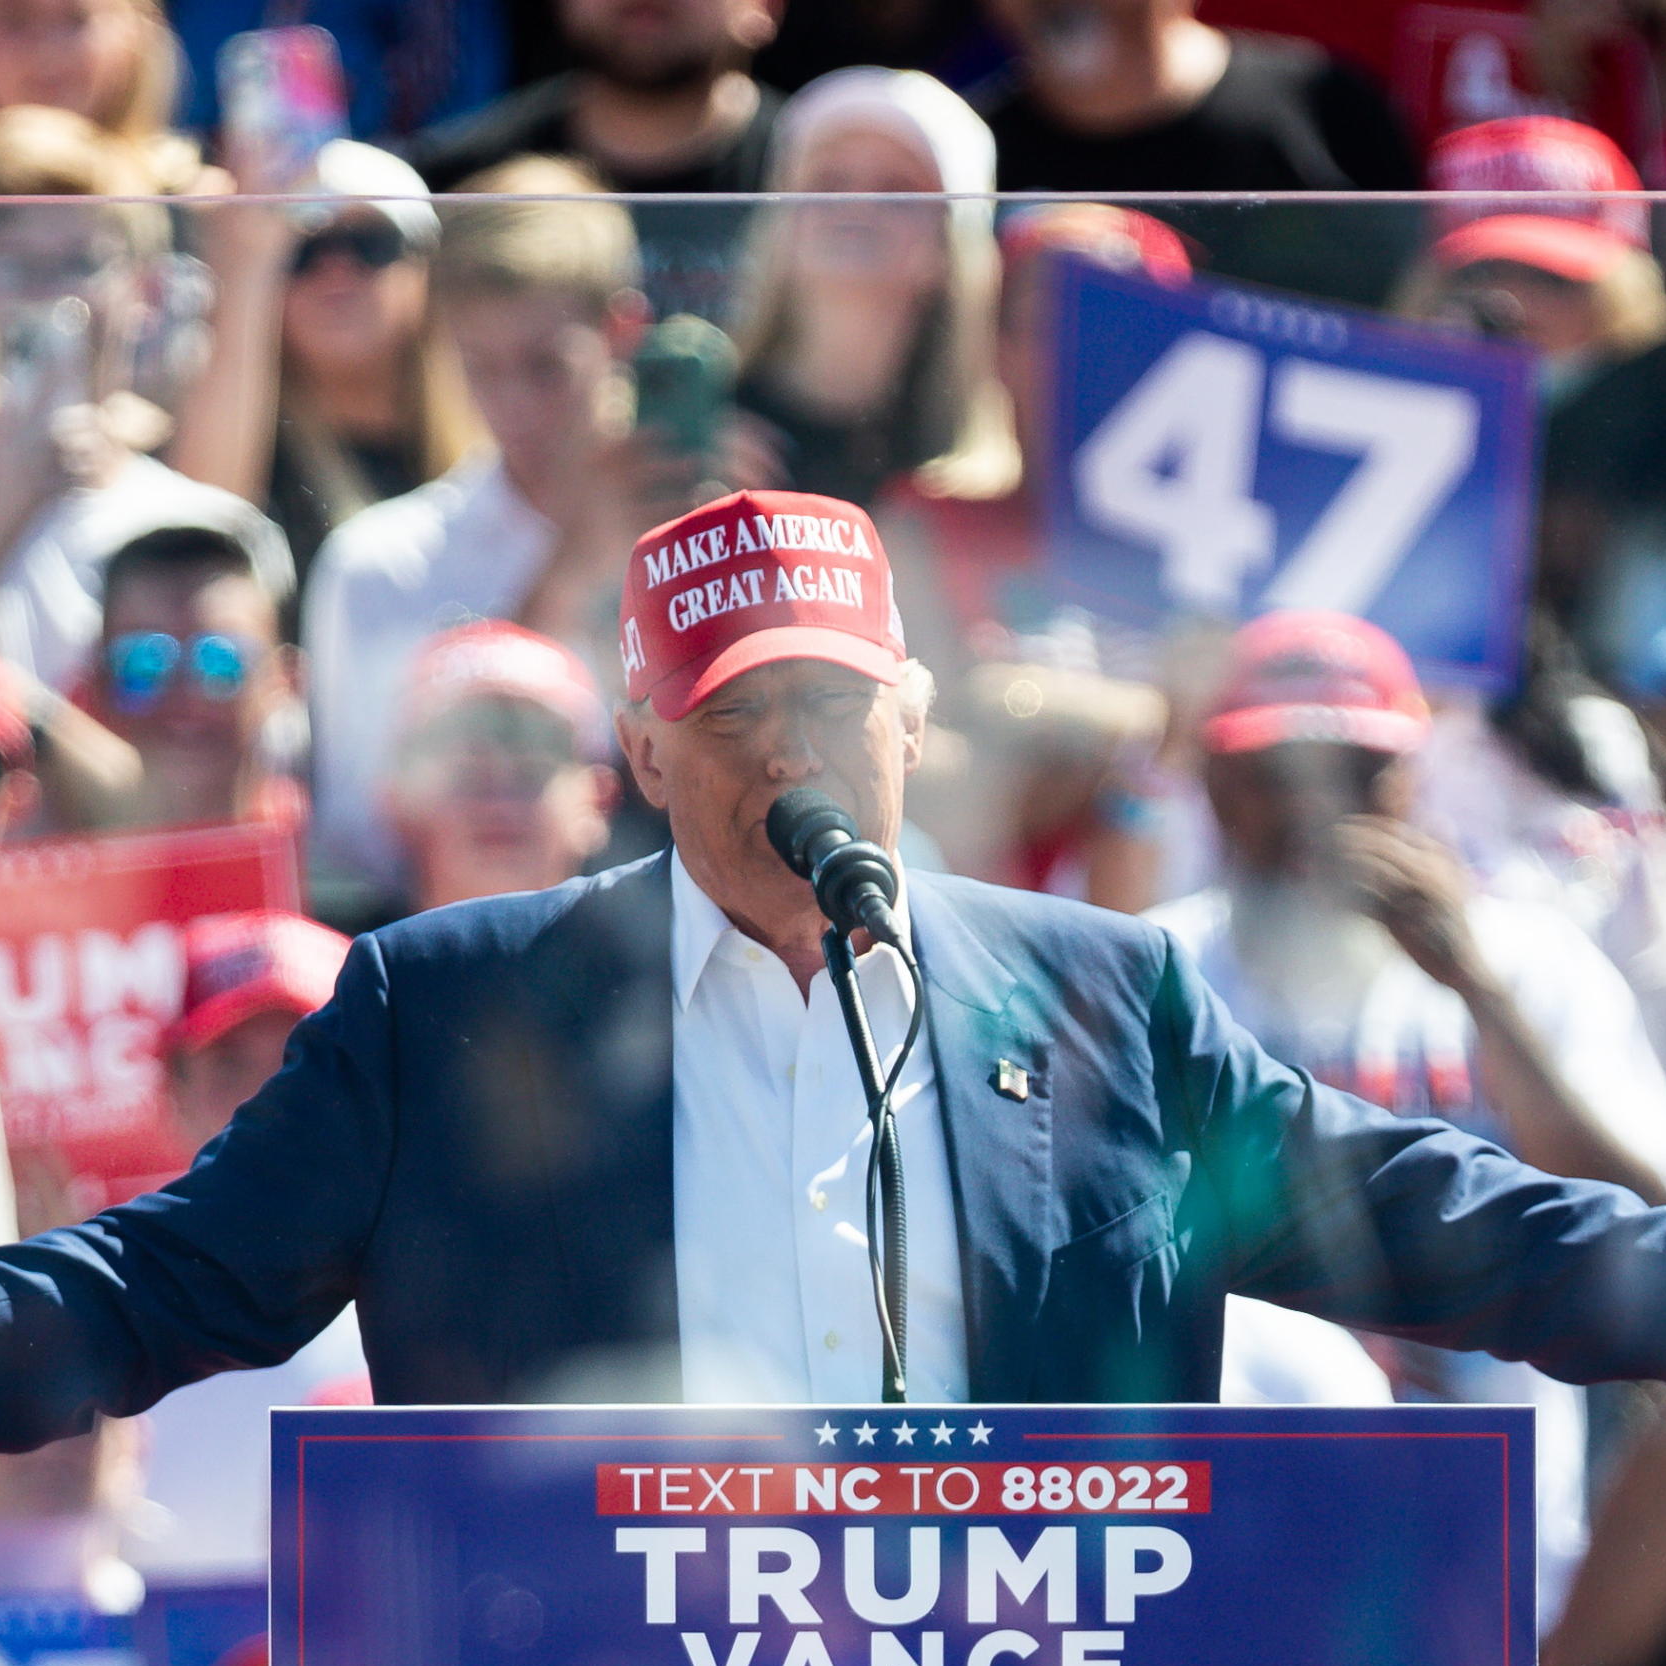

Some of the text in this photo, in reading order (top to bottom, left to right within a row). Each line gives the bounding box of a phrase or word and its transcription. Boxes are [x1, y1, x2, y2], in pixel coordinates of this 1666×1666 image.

[1074, 328, 1480, 615] 47
[644, 513, 874, 589] MAKE AMERICA
[668, 564, 864, 633] GREAT AGAIN
[619, 1464, 1190, 1512] TEXT NC TO 88022
[615, 1525, 1193, 1626] TRUMP
